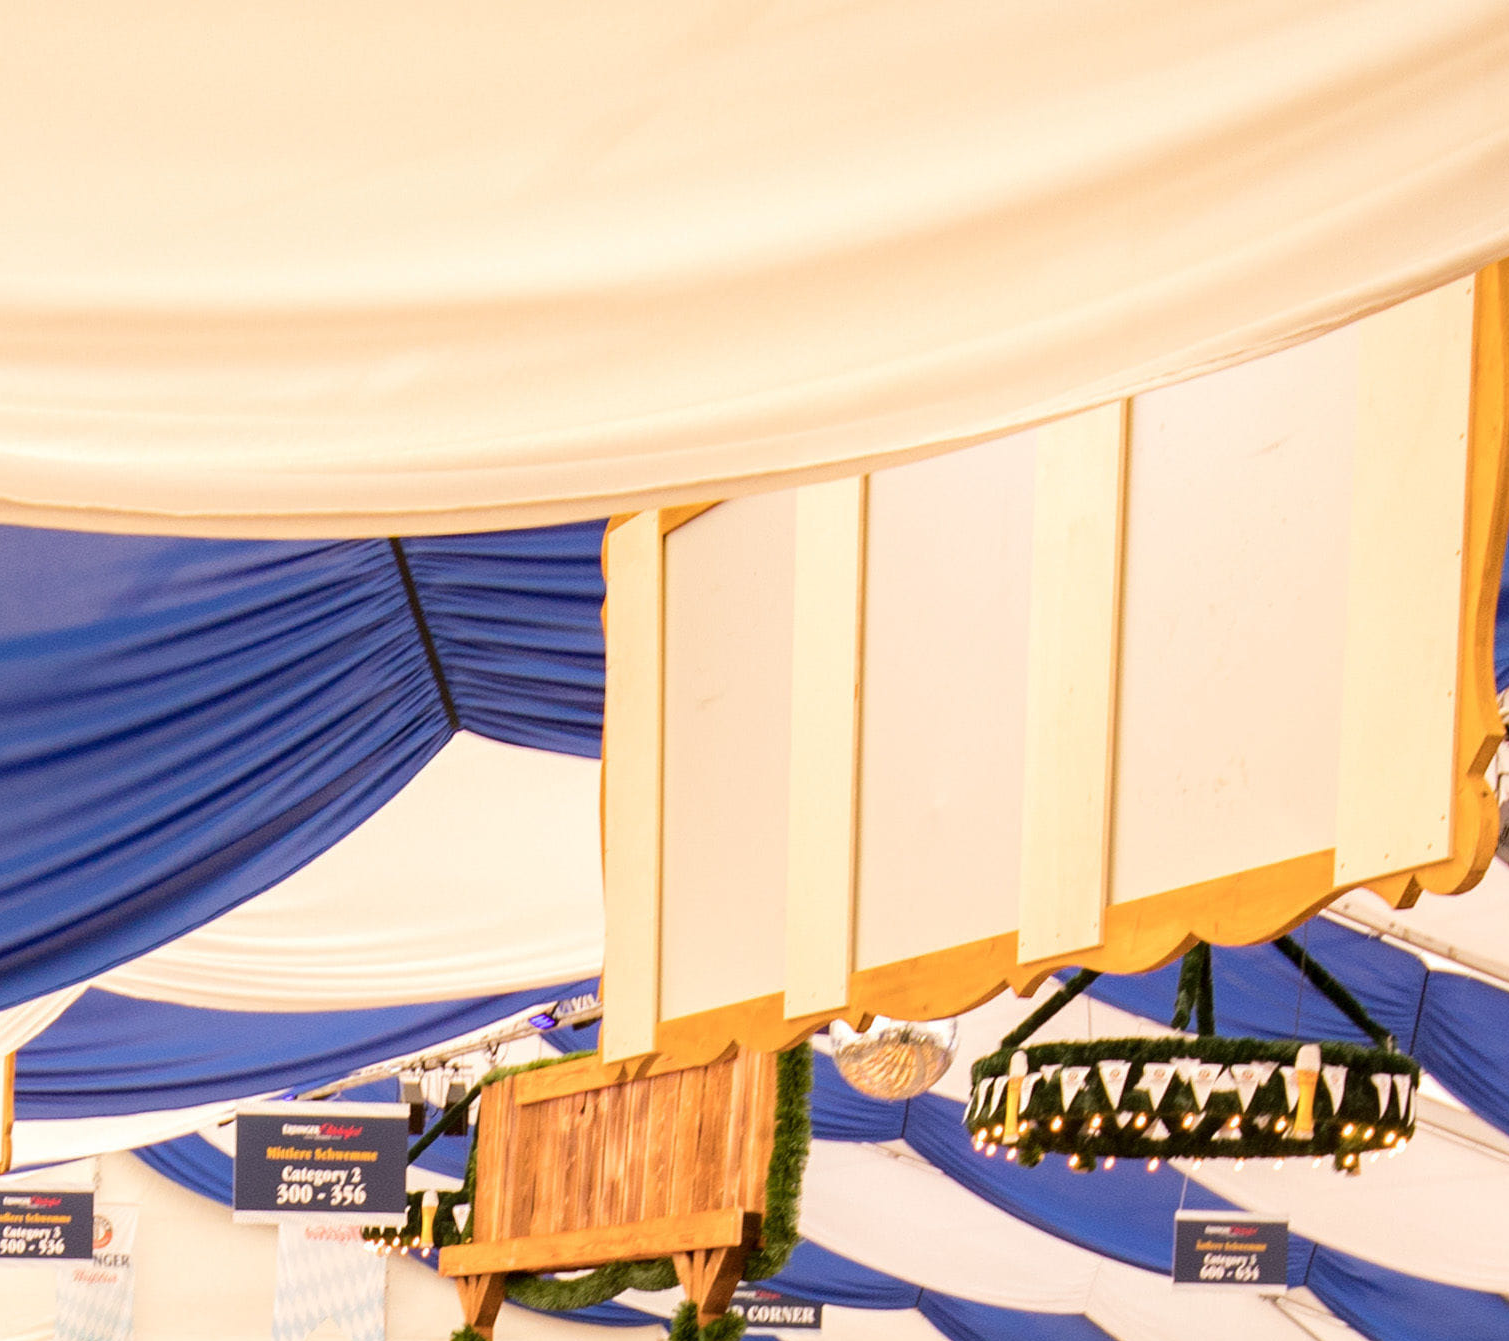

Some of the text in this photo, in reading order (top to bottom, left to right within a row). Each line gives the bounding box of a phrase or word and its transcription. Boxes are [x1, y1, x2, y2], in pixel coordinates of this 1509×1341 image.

[314, 1147, 378, 1162] Schwemme
[282, 1165, 362, 1187] Category 2
[276, 1183, 313, 1205] 300
[330, 1183, 367, 1206] 356
[3, 1226, 52, 1242] Category
[0, 1238, 27, 1255] 500
[94, 1254, 130, 1267] NGER
[747, 1304, 815, 1323] CORNER
